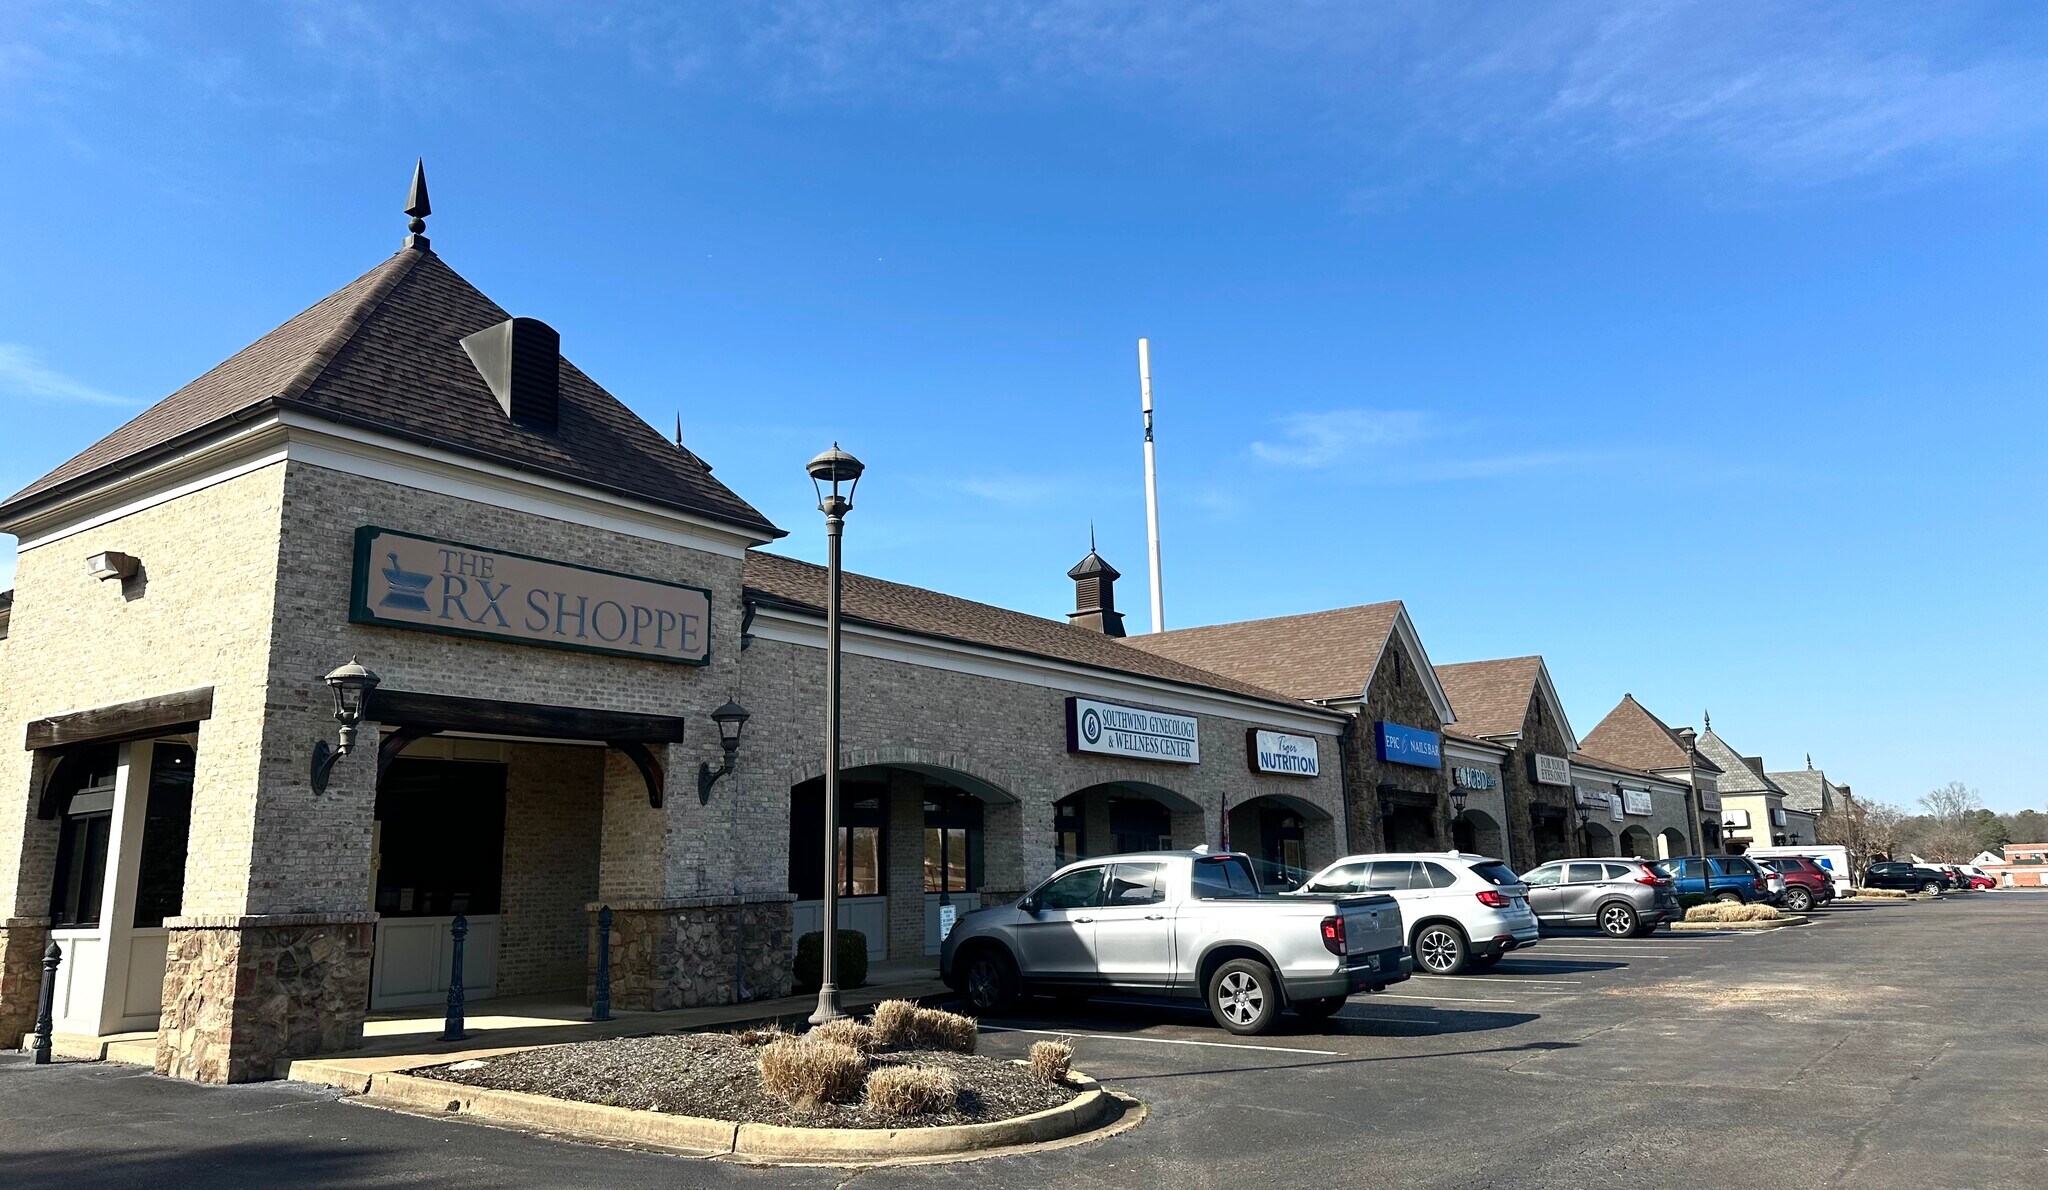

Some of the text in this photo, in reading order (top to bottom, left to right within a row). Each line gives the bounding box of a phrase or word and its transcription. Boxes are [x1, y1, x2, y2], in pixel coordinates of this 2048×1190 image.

[438, 549, 495, 579] THE
[438, 572, 701, 653] RX SHOPPE
[1102, 708, 1195, 738] SOUTHWIND GYNECOLOGY
[1108, 732, 1192, 758] & WELLNESS CENTER
[1385, 734, 1400, 749] EPIC
[1260, 751, 1316, 774] NUTRITION
[1540, 756, 1551, 769] FOR
